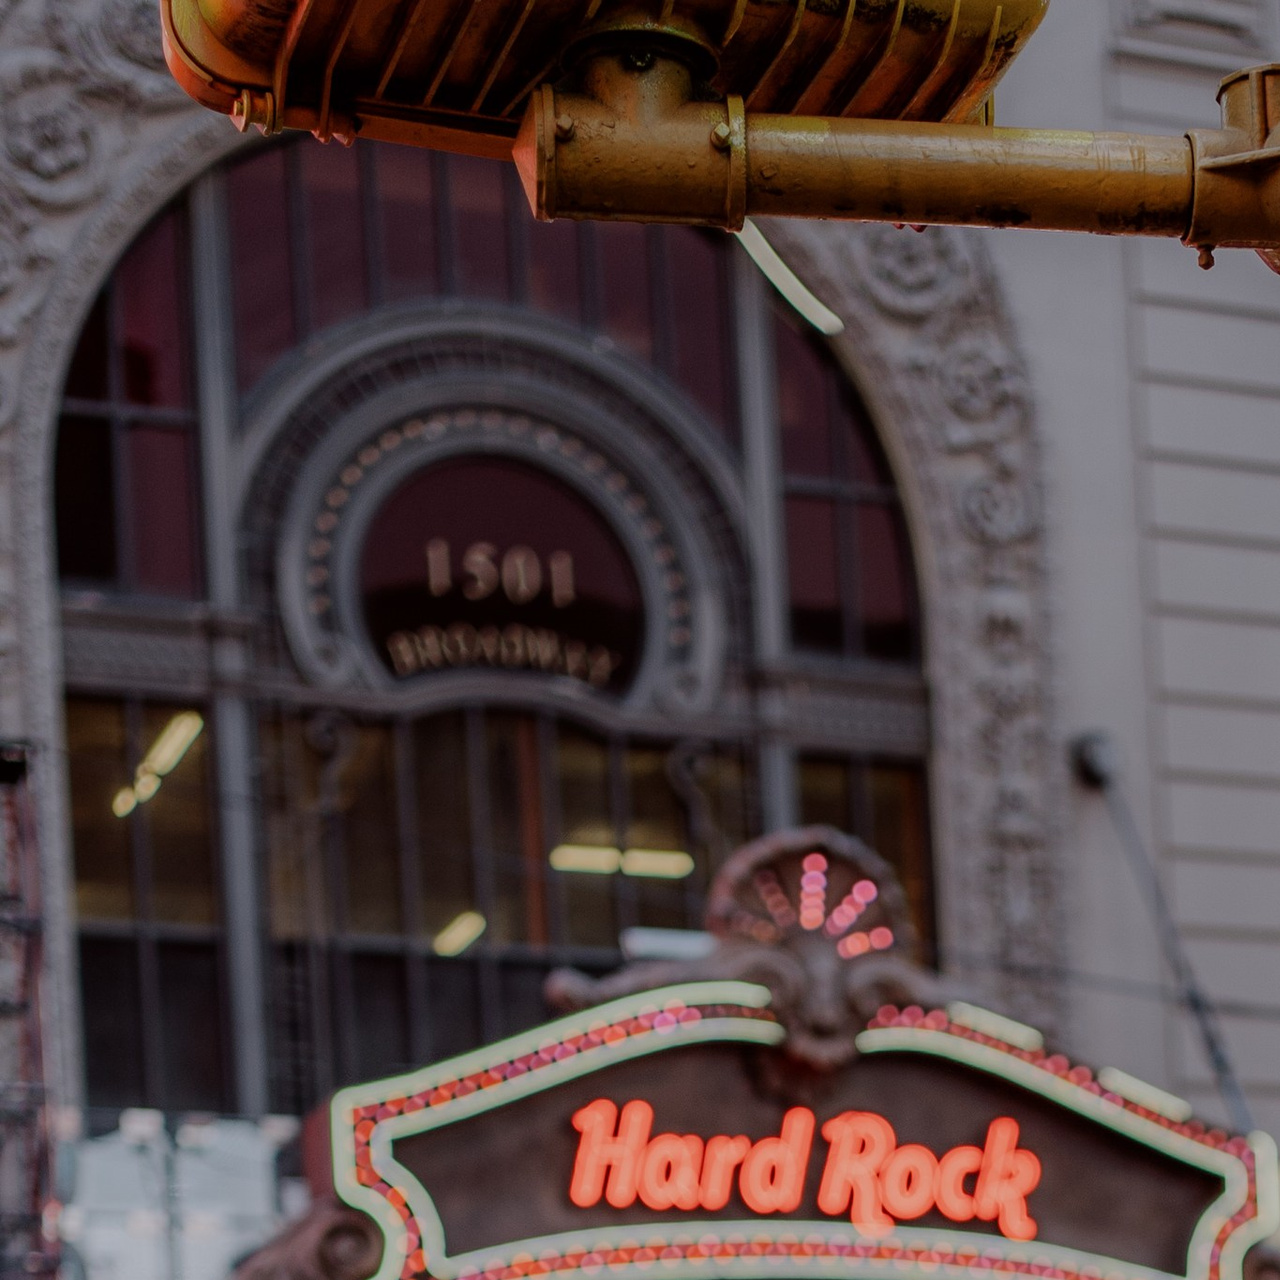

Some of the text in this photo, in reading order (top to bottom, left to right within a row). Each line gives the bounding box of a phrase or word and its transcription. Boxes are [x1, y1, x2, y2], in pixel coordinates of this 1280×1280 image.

[426, 537, 577, 608] 1501
[569, 1099, 1042, 1241] Hard Rock
